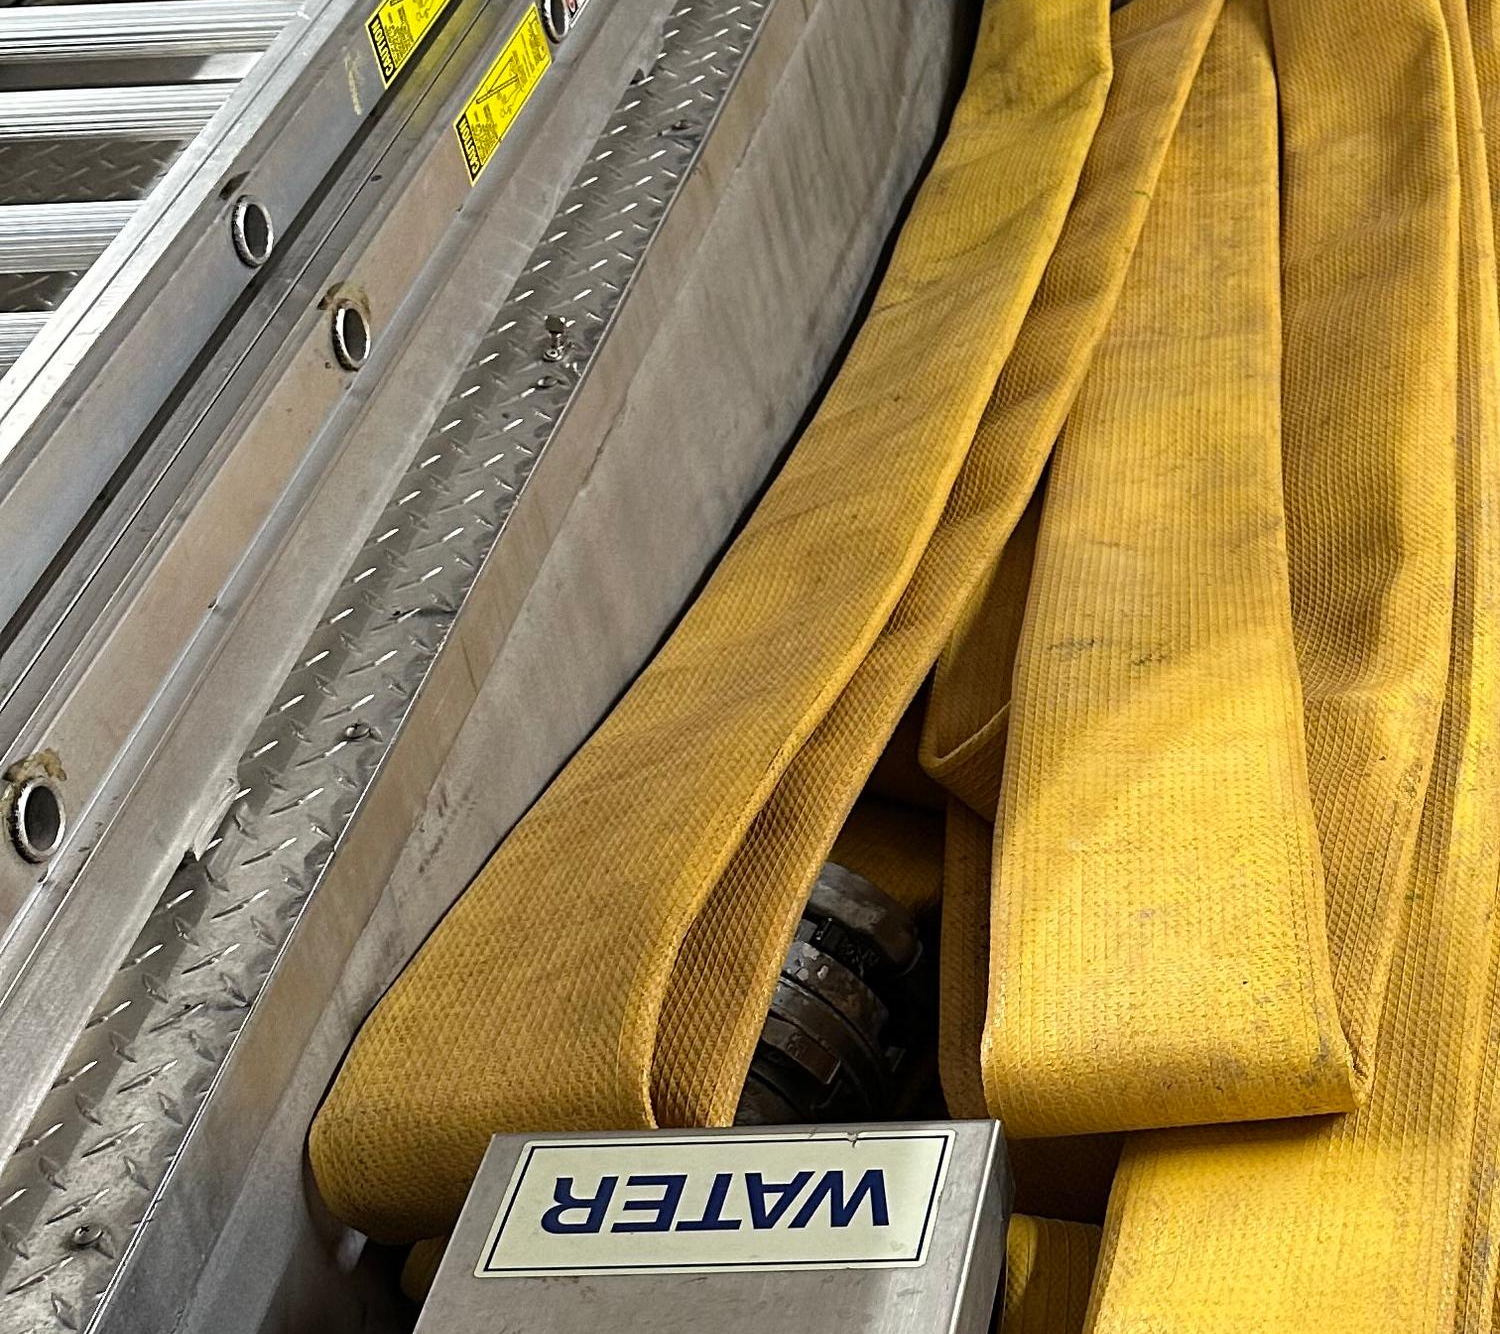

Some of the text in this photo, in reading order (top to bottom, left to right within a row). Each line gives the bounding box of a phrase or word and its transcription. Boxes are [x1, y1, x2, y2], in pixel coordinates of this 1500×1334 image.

[370, 18, 394, 77] CAUTION
[458, 118, 480, 174] CAUTION
[540, 1168, 890, 1235] WATER
